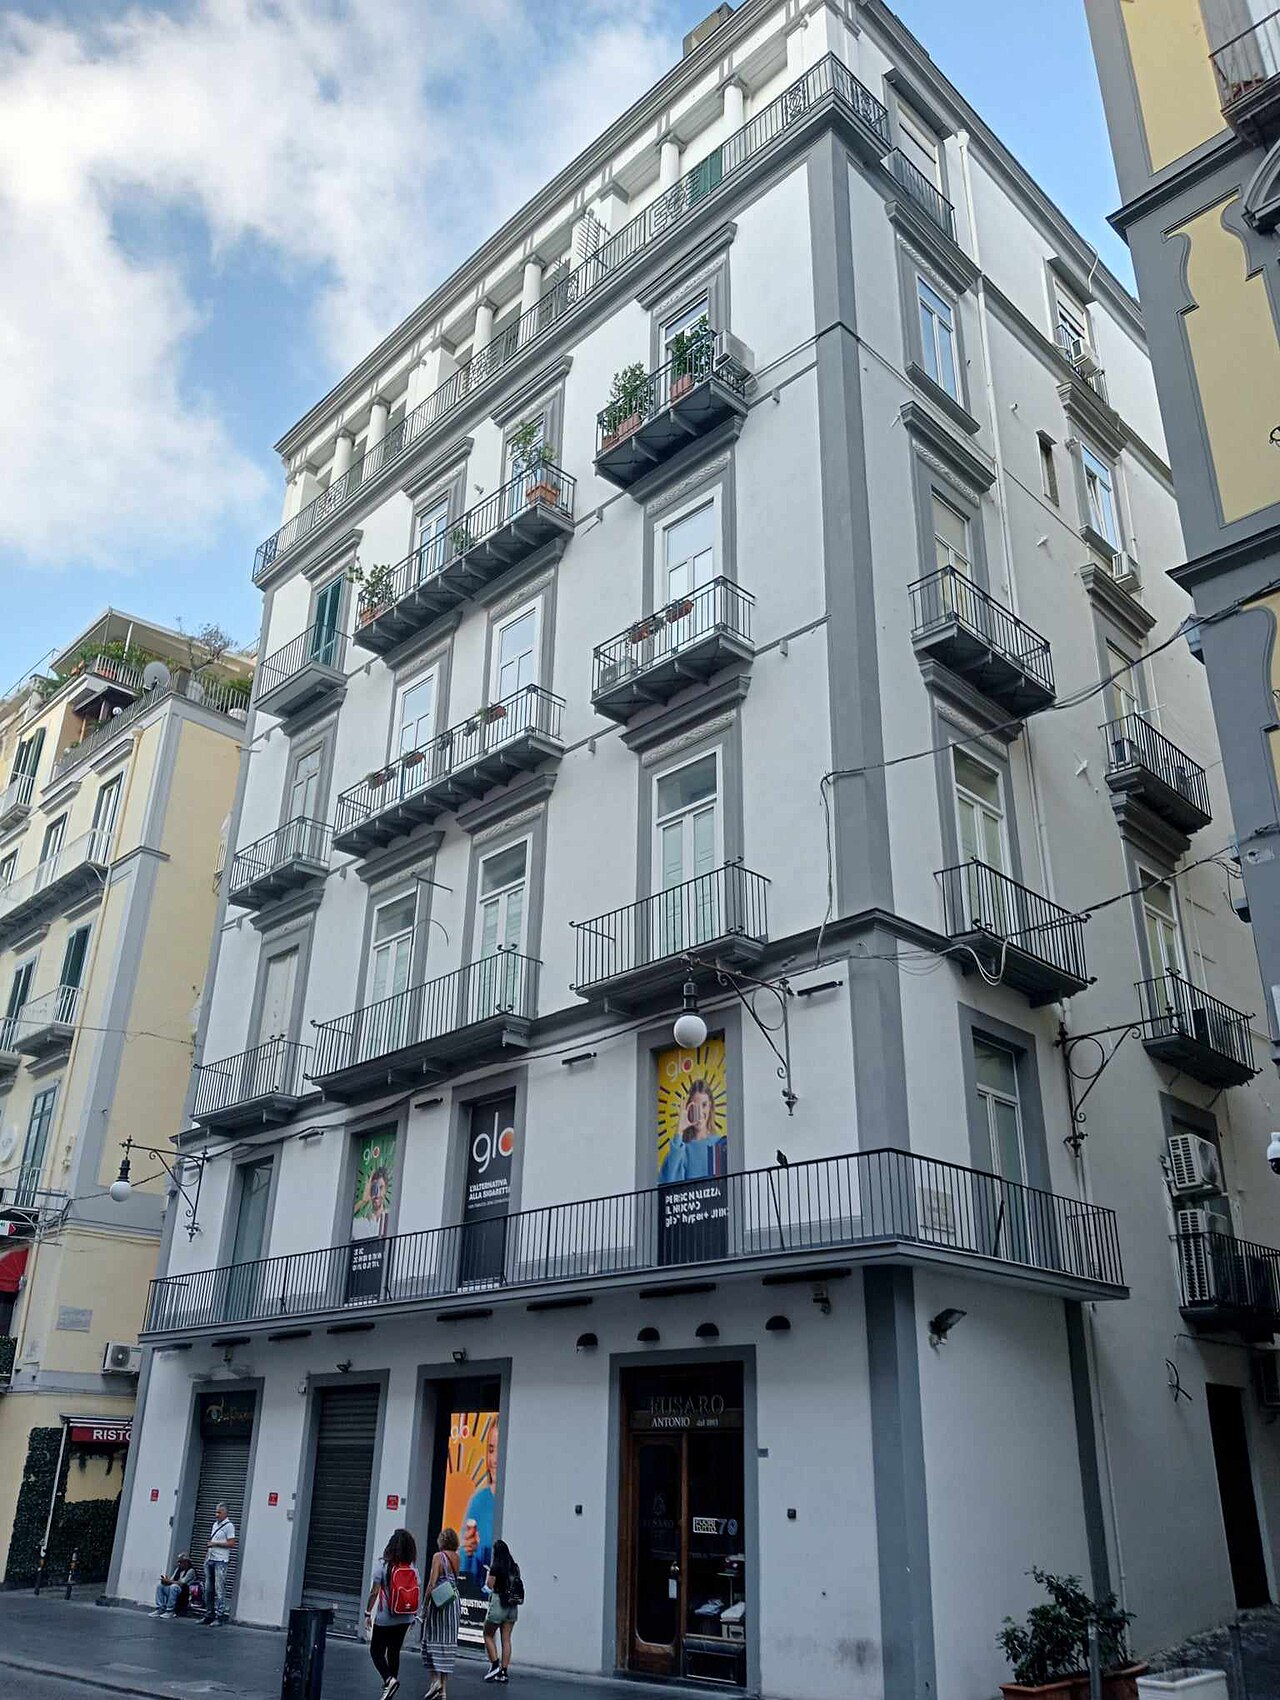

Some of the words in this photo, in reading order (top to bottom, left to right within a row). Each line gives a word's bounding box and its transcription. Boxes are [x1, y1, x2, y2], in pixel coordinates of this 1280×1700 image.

[666, 1051, 694, 1082] glo
[363, 1140, 380, 1165] glo
[472, 1111, 515, 1173] glo
[468, 1191, 482, 1201] ALLA
[651, 1416, 690, 1427] ANTONIO
